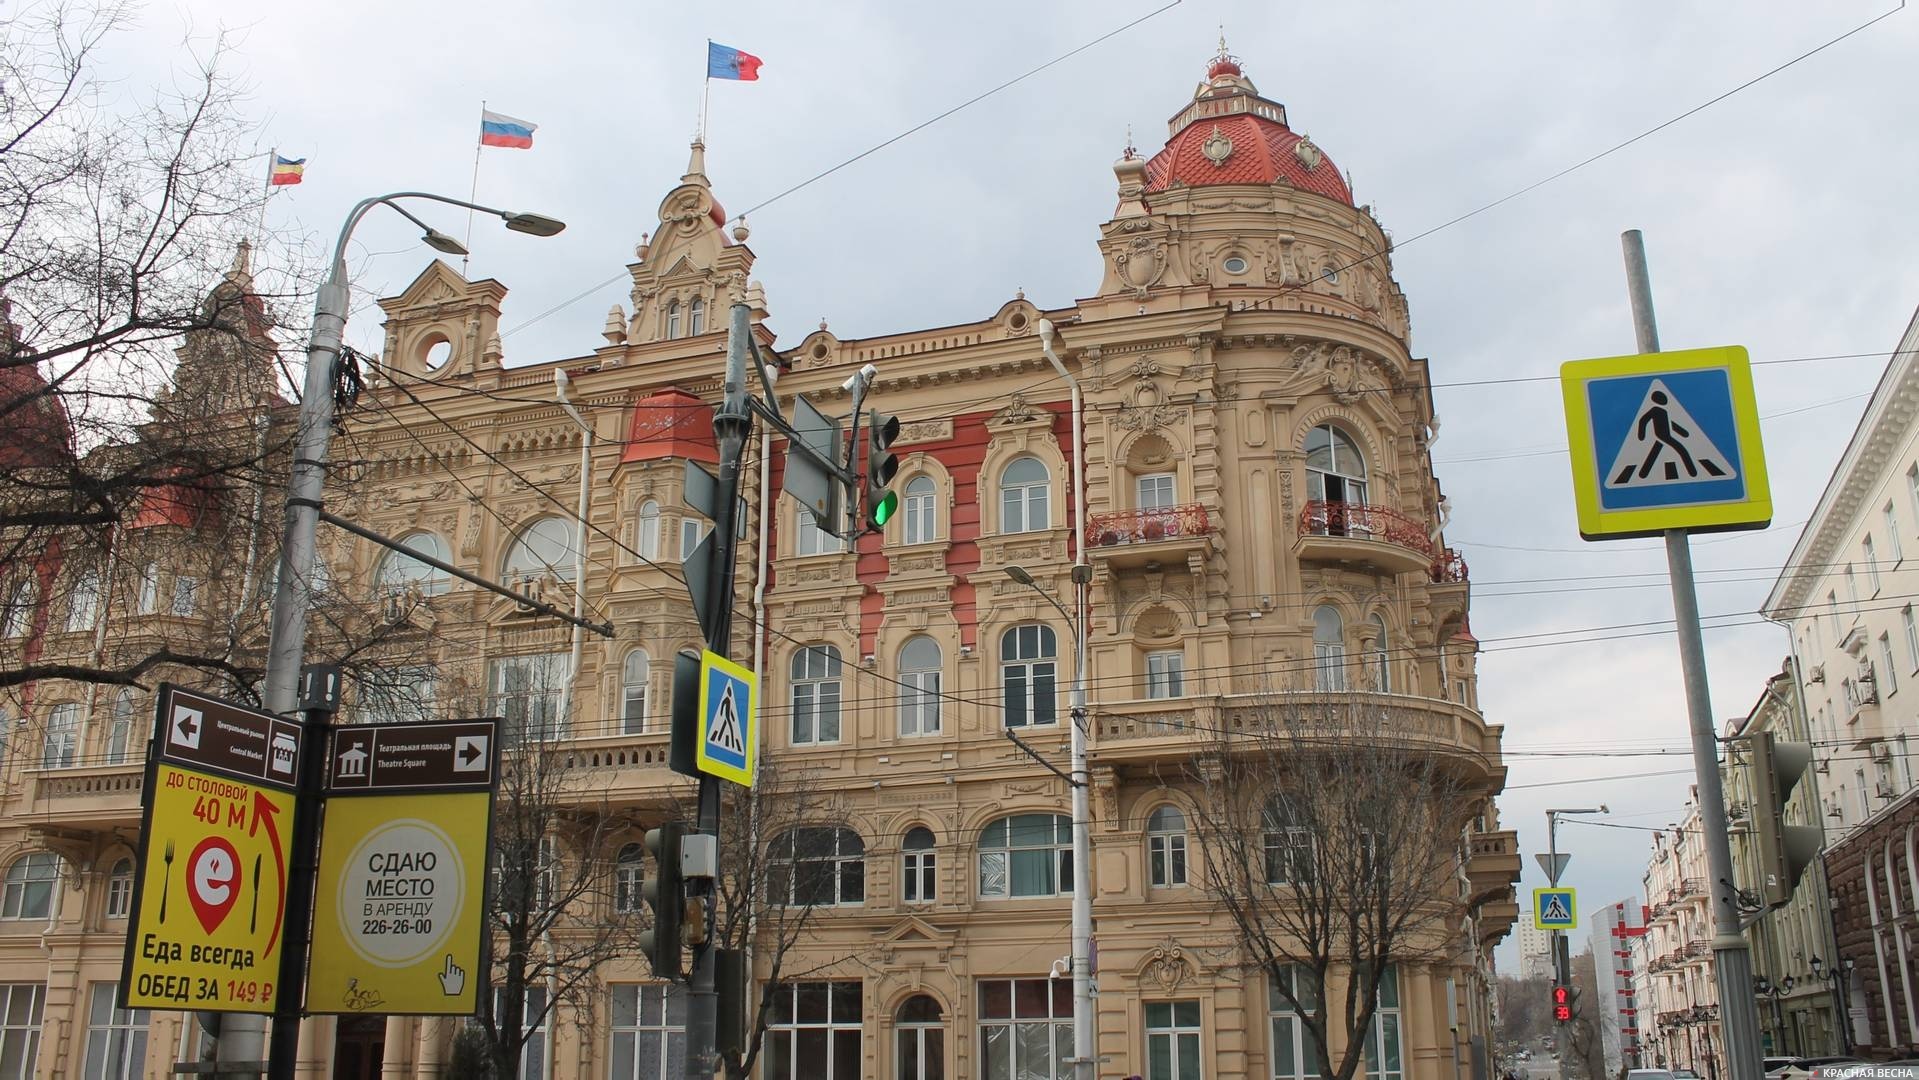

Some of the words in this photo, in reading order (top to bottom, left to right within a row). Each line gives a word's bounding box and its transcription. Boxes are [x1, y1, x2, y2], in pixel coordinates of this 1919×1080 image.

[217, 720, 250, 736] Центральный
[229, 745, 247, 757] Central
[247, 750, 263, 761] Market
[379, 744, 420, 754] Театральная
[421, 742, 452, 752] площадь
[377, 759, 402, 769] Theatre
[403, 759, 427, 770] Square
[166, 771, 184, 788] ДО
[187, 776, 249, 802] СТОЛОВОЙ
[192, 795, 221, 825] 40
[227, 802, 247, 831] М
[368, 851, 437, 877] СДАЮ
[365, 878, 435, 897] МЕСТО
[363, 903, 373, 917] В
[376, 902, 434, 918] АРЕНДУ
[362, 918, 432, 935] 226-26-00
[142, 933, 182, 965] Еда
[190, 944, 255, 971] всегда
[137, 973, 191, 1003] ОБЕД
[195, 977, 219, 1001] ЗА
[227, 980, 257, 1004] 149
